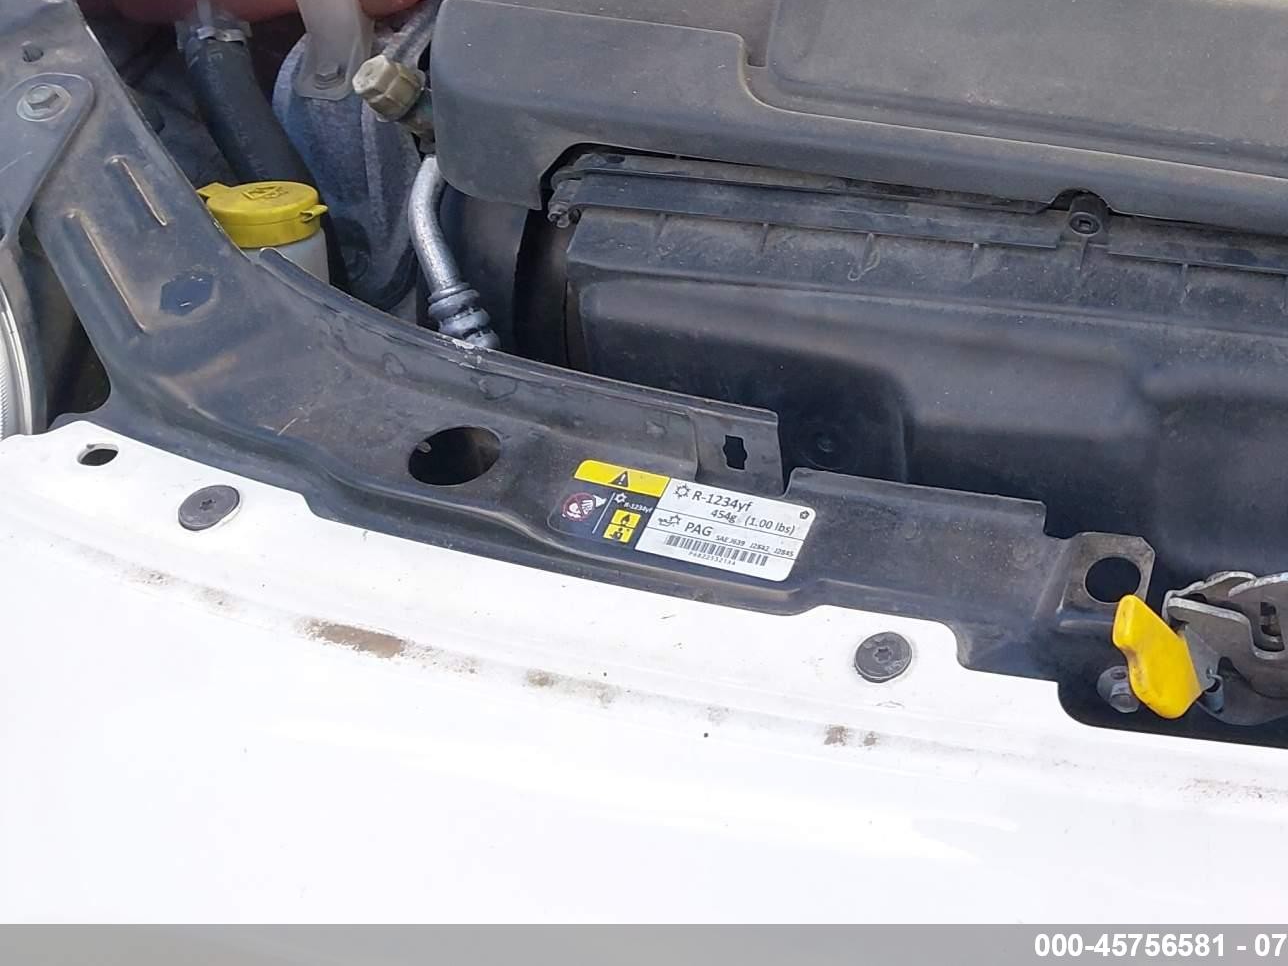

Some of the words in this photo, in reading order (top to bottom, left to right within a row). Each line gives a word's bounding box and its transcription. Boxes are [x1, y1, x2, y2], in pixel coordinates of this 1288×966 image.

[692, 490, 754, 513] R-1234yf
[684, 521, 714, 537] PAG
[711, 509, 737, 523] 454g
[744, 515, 774, 530] (1.00
[774, 521, 796, 536] lbs)
